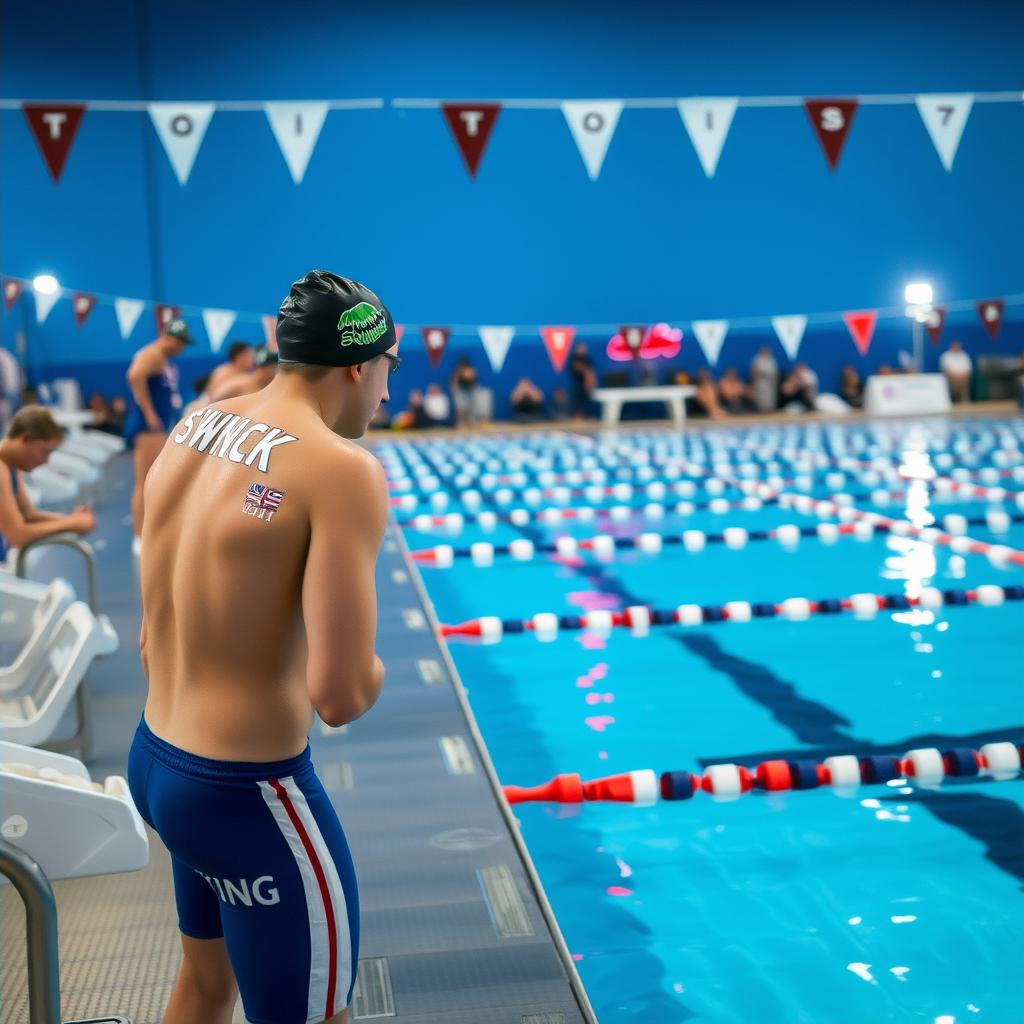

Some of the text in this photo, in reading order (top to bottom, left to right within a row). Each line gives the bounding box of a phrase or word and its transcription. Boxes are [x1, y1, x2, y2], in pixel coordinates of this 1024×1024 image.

[43, 112, 67, 139] T
[170, 113, 194, 137] O
[460, 111, 484, 137] T
[582, 111, 605, 134] O
[821, 106, 845, 132] S
